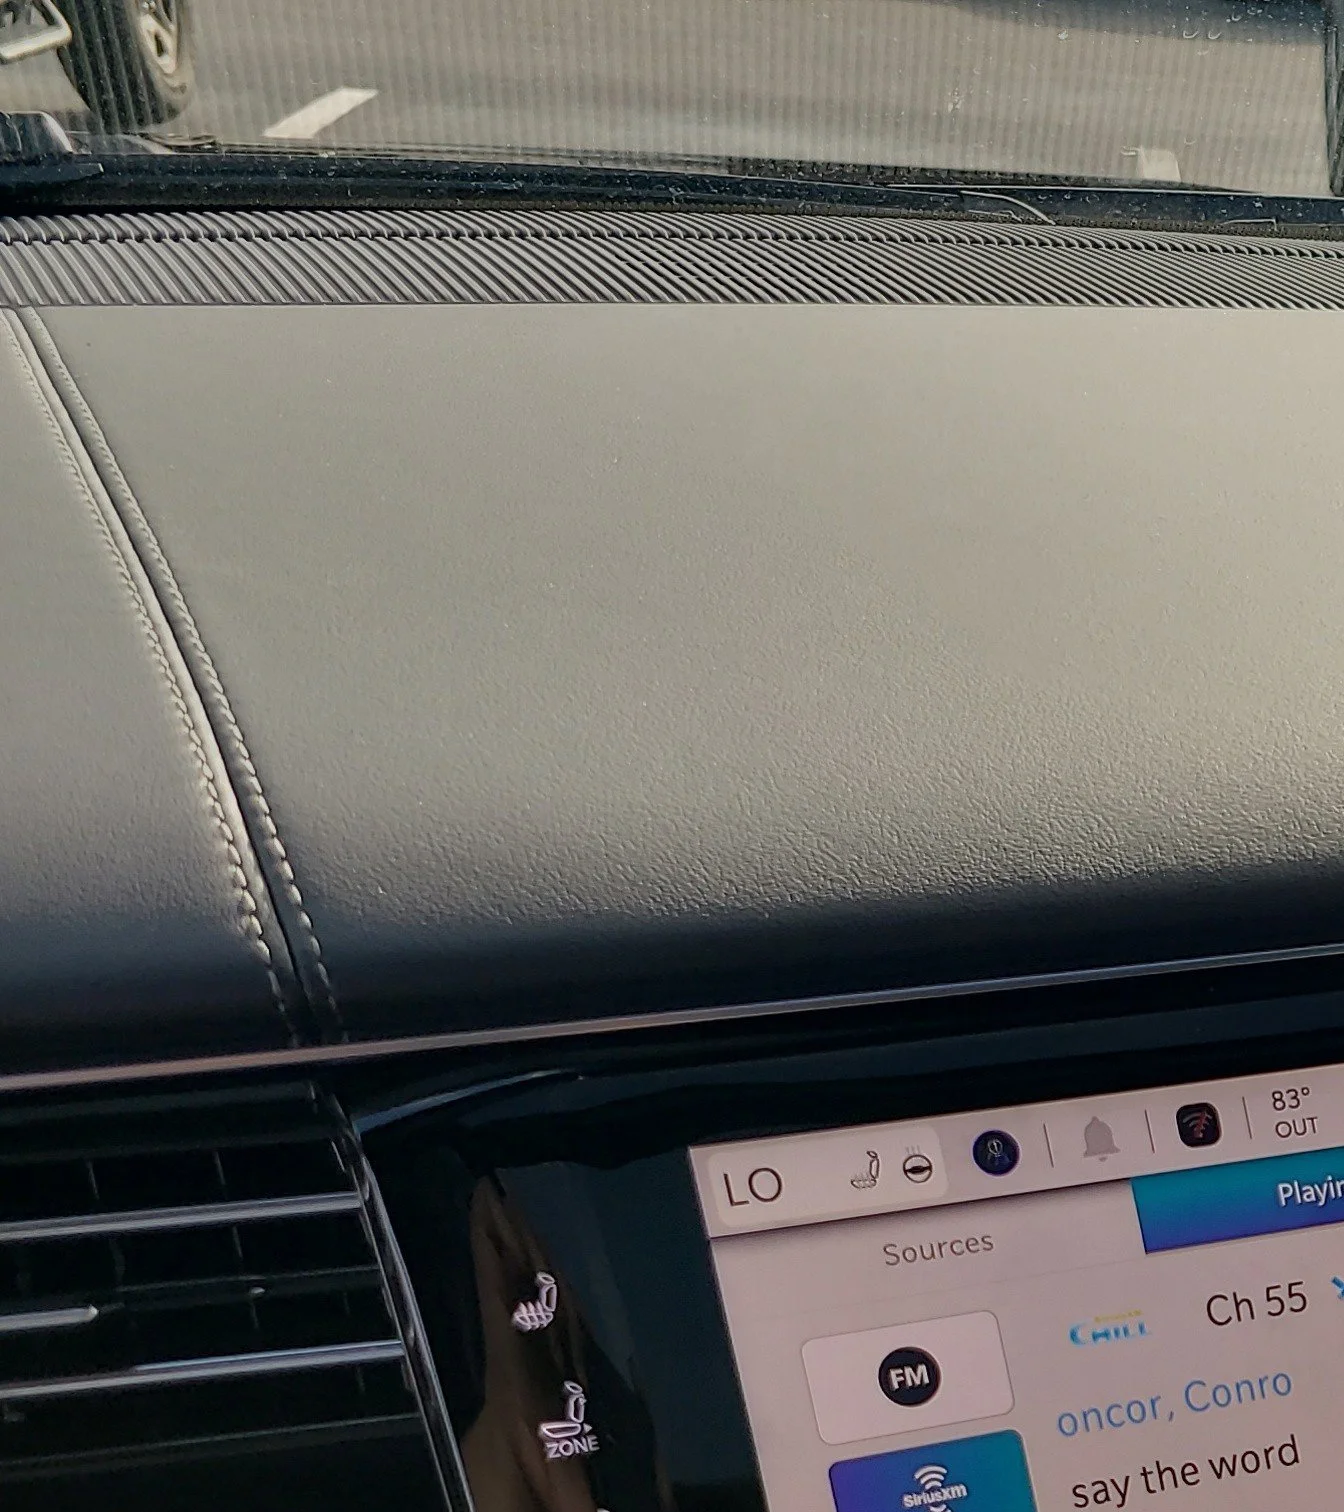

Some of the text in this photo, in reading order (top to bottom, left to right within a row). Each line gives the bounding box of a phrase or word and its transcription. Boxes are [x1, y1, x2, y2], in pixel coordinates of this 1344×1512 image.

[1270, 1086, 1311, 1112] 83°
[1275, 1115, 1319, 1139] OUT
[723, 1165, 784, 1208] LO
[882, 1230, 995, 1268] Sources
[1205, 1280, 1309, 1329] Ch 55
[889, 1361, 930, 1393] FM
[1057, 1367, 1294, 1440] oncor, Conro
[545, 1434, 600, 1459] ZONE
[1071, 1434, 1302, 1510] say the word
